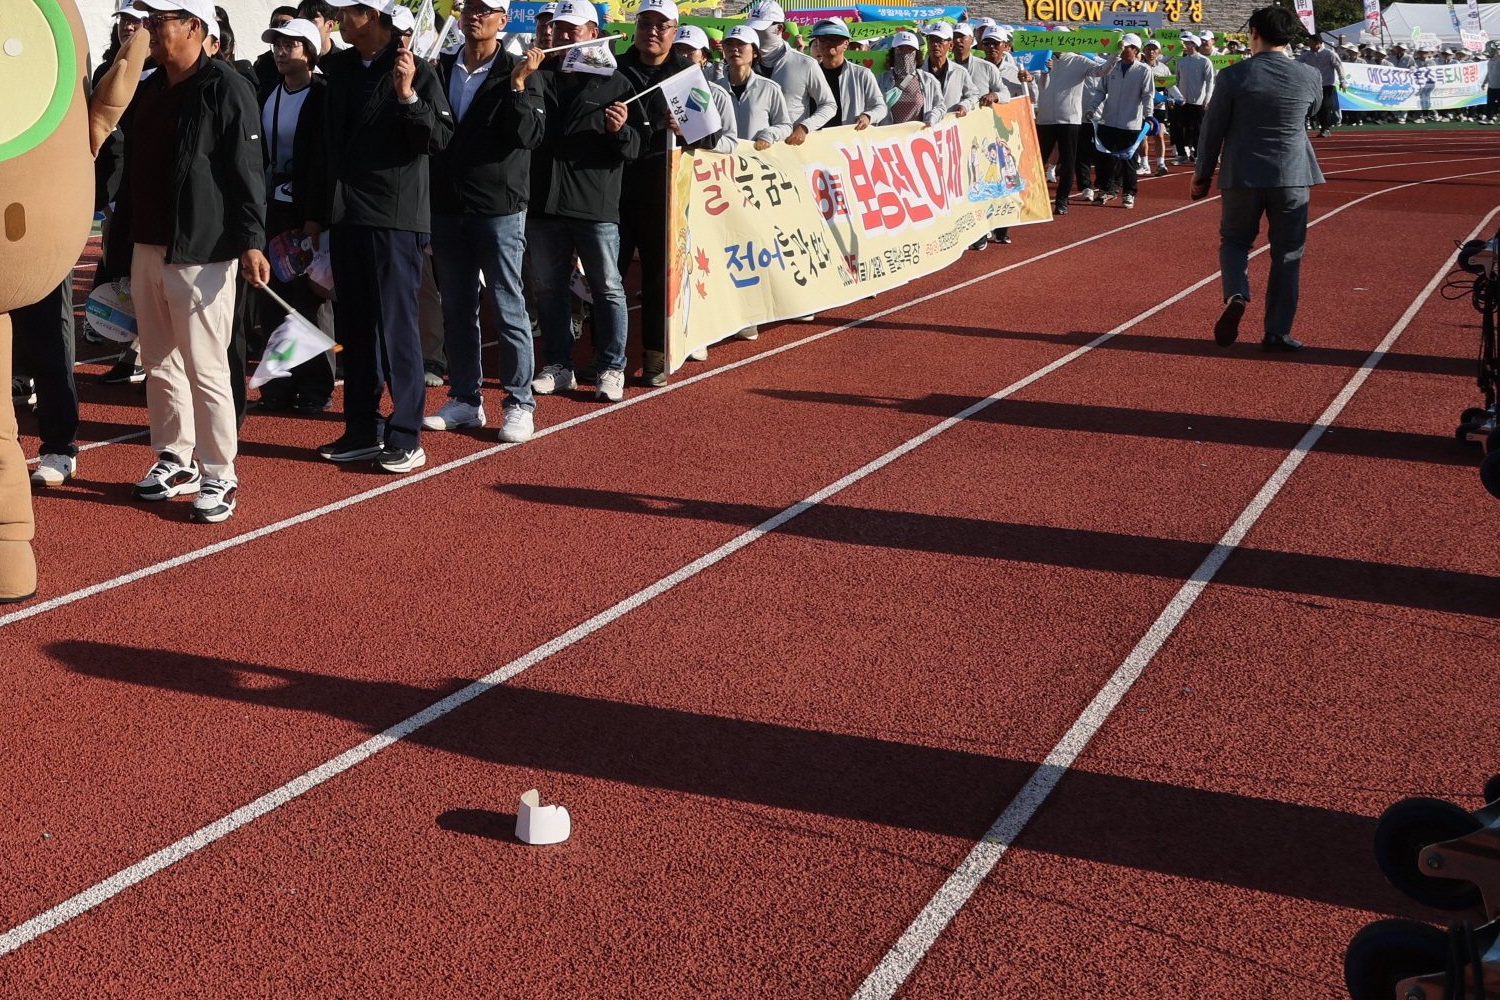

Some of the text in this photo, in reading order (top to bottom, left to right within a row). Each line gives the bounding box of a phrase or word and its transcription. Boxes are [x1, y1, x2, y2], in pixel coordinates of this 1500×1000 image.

[1019, 33, 1100, 48] 친구야! 보성가자
[670, 96, 689, 125] 보성군
[994, 201, 1016, 217] 보성군
